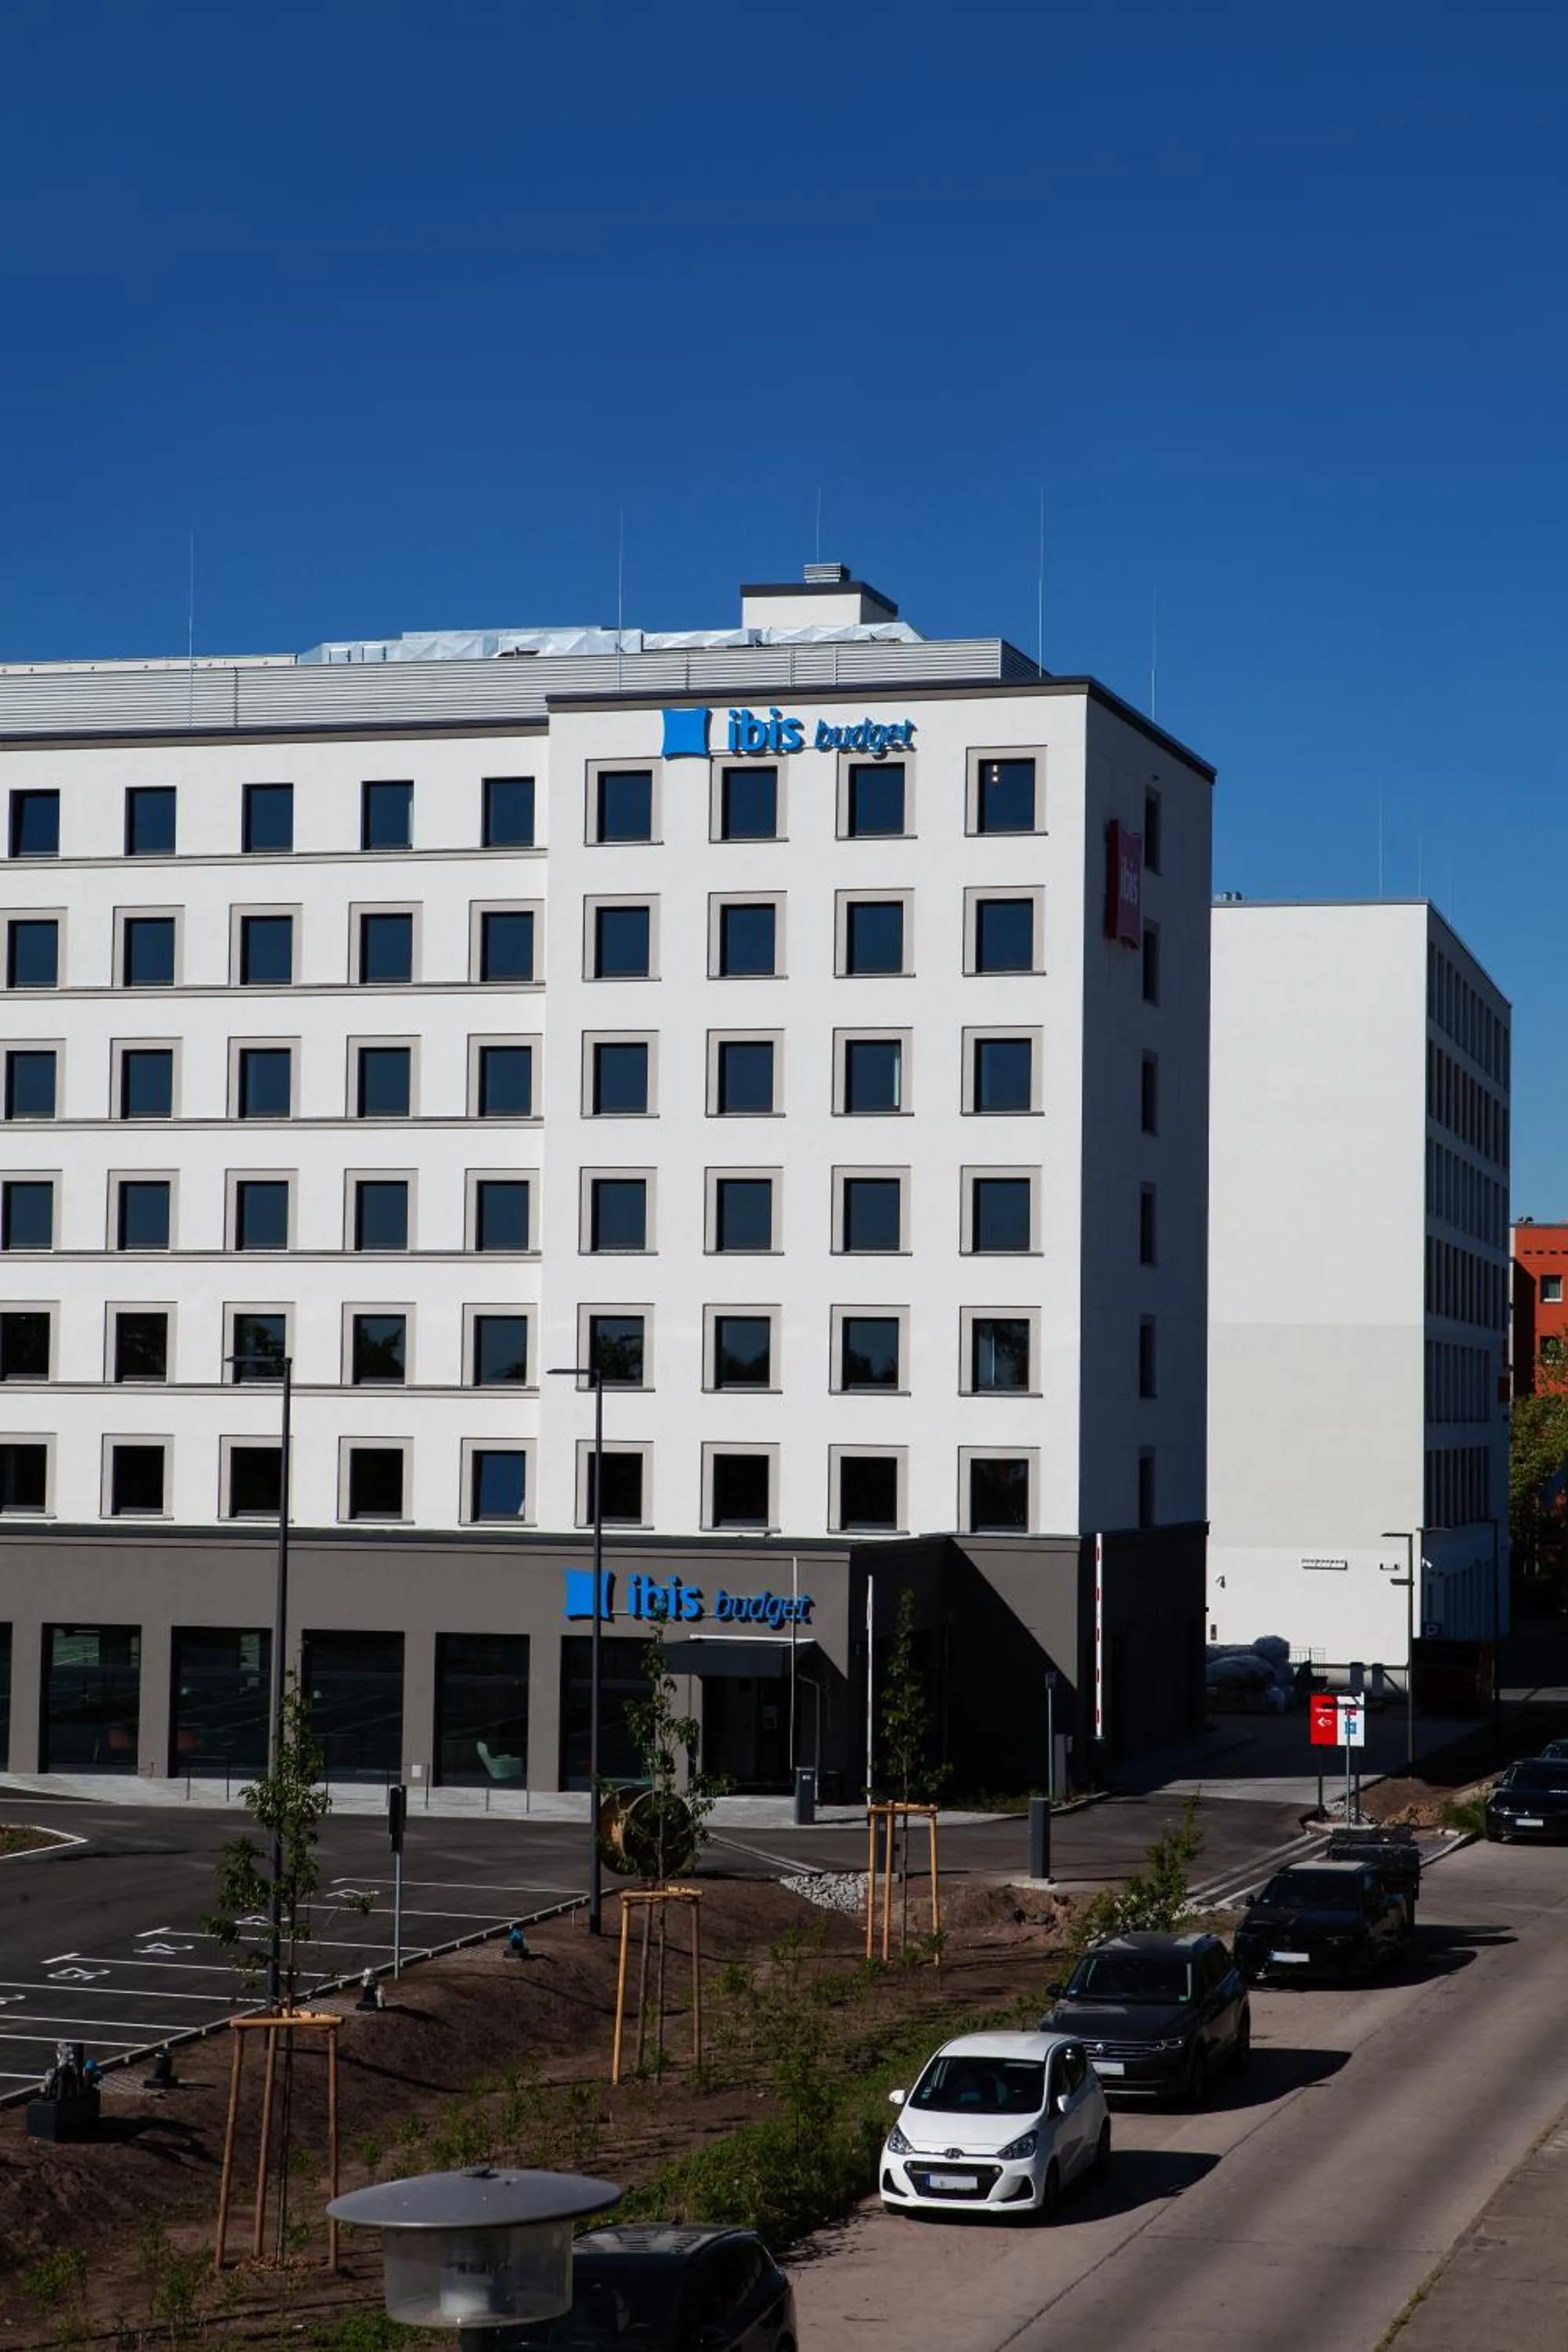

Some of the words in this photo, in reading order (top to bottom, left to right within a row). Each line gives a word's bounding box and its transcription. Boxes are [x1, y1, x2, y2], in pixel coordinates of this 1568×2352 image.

[728, 707, 804, 753] ibis
[815, 717, 916, 756] budget
[1120, 856, 1138, 906] ibis
[629, 1572, 702, 1621] ibis
[714, 1589, 812, 1627] budget
